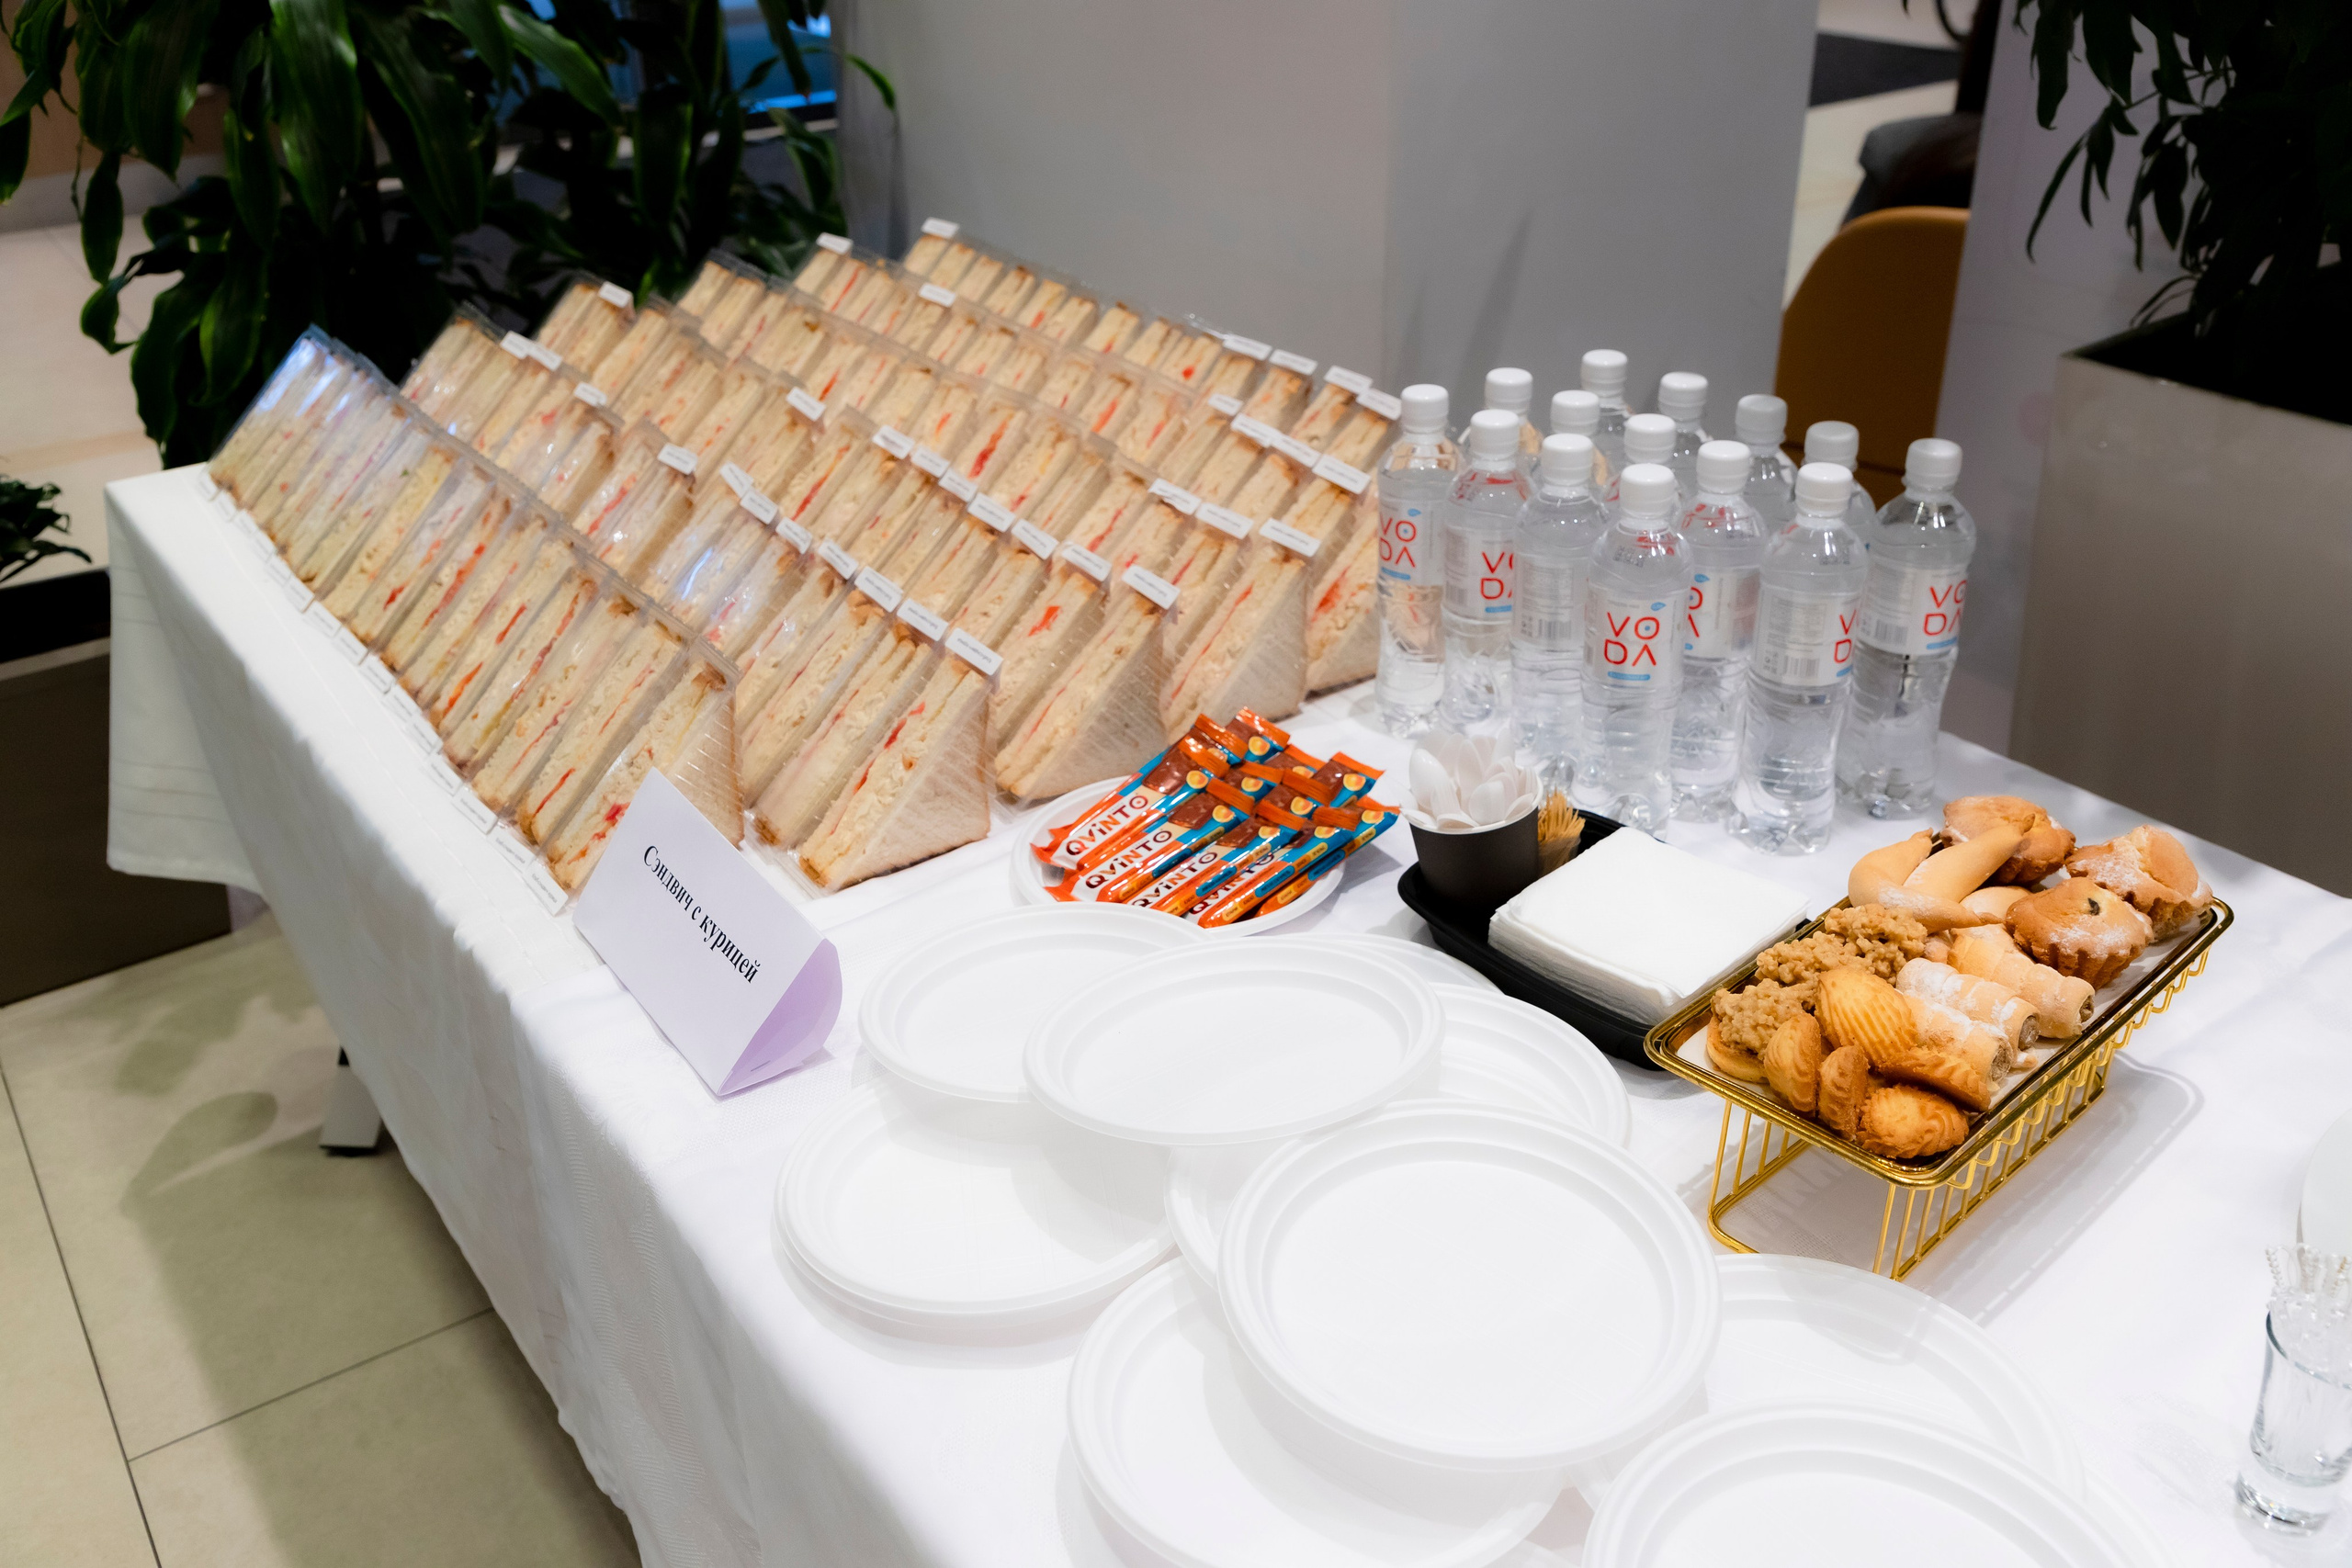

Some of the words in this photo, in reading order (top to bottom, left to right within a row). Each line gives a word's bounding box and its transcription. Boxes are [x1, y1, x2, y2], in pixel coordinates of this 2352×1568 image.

[1482, 551, 1514, 574] V
[1480, 578, 1513, 600] D
[1607, 611, 1660, 640] VO
[1604, 638, 1657, 667] DA
[644, 846, 694, 911] Сэндвич
[691, 906, 702, 920] с
[699, 915, 762, 984] курицей
